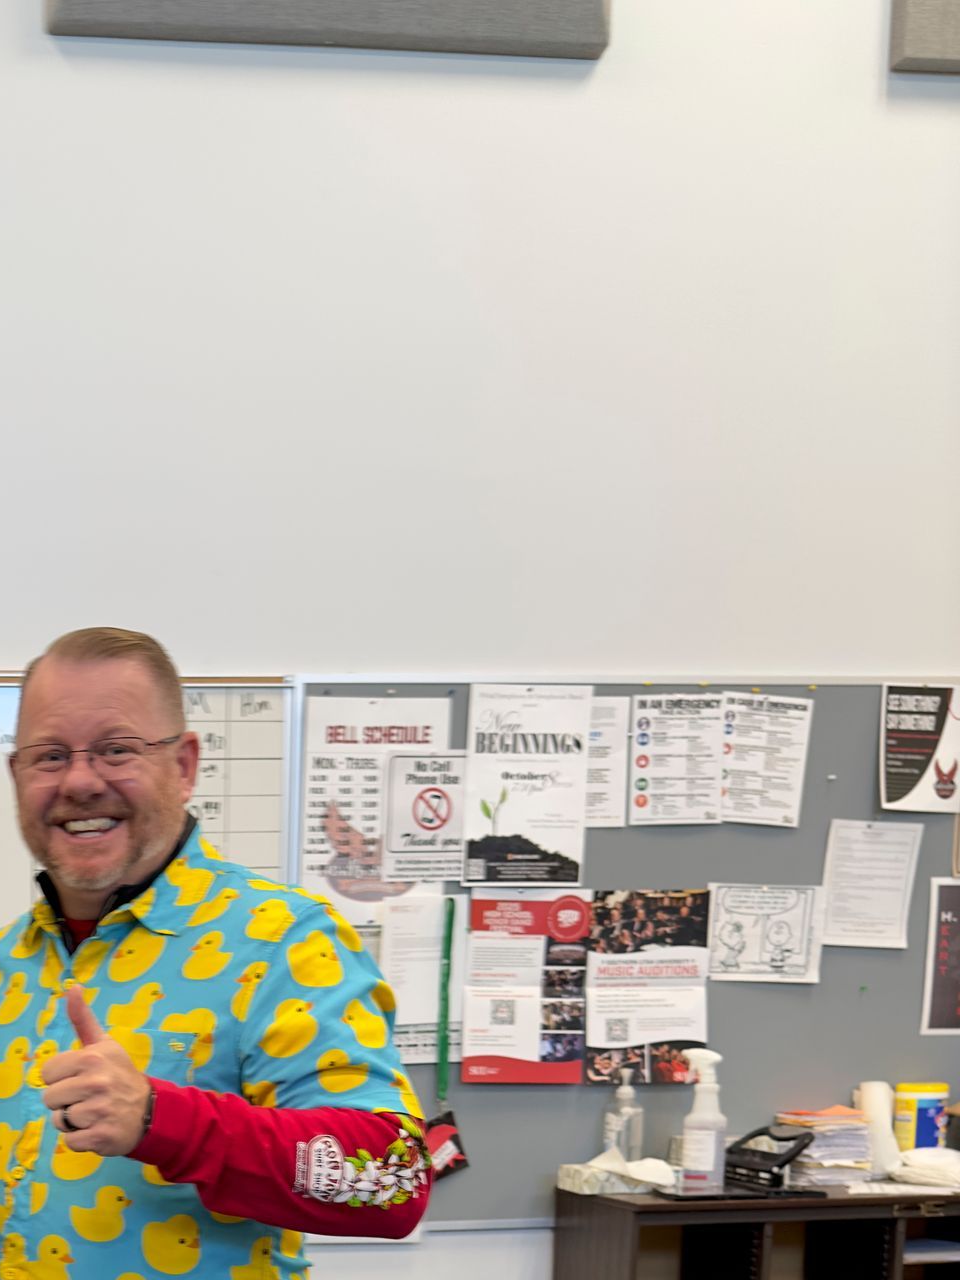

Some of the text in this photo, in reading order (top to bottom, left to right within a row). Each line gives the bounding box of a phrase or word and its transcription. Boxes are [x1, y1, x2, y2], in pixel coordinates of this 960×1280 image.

[326, 726, 432, 743] BELL SCHEDULE
[475, 732, 583, 754] BEGINNINGS
[597, 965, 699, 976] MUSIC AUDITIONS
